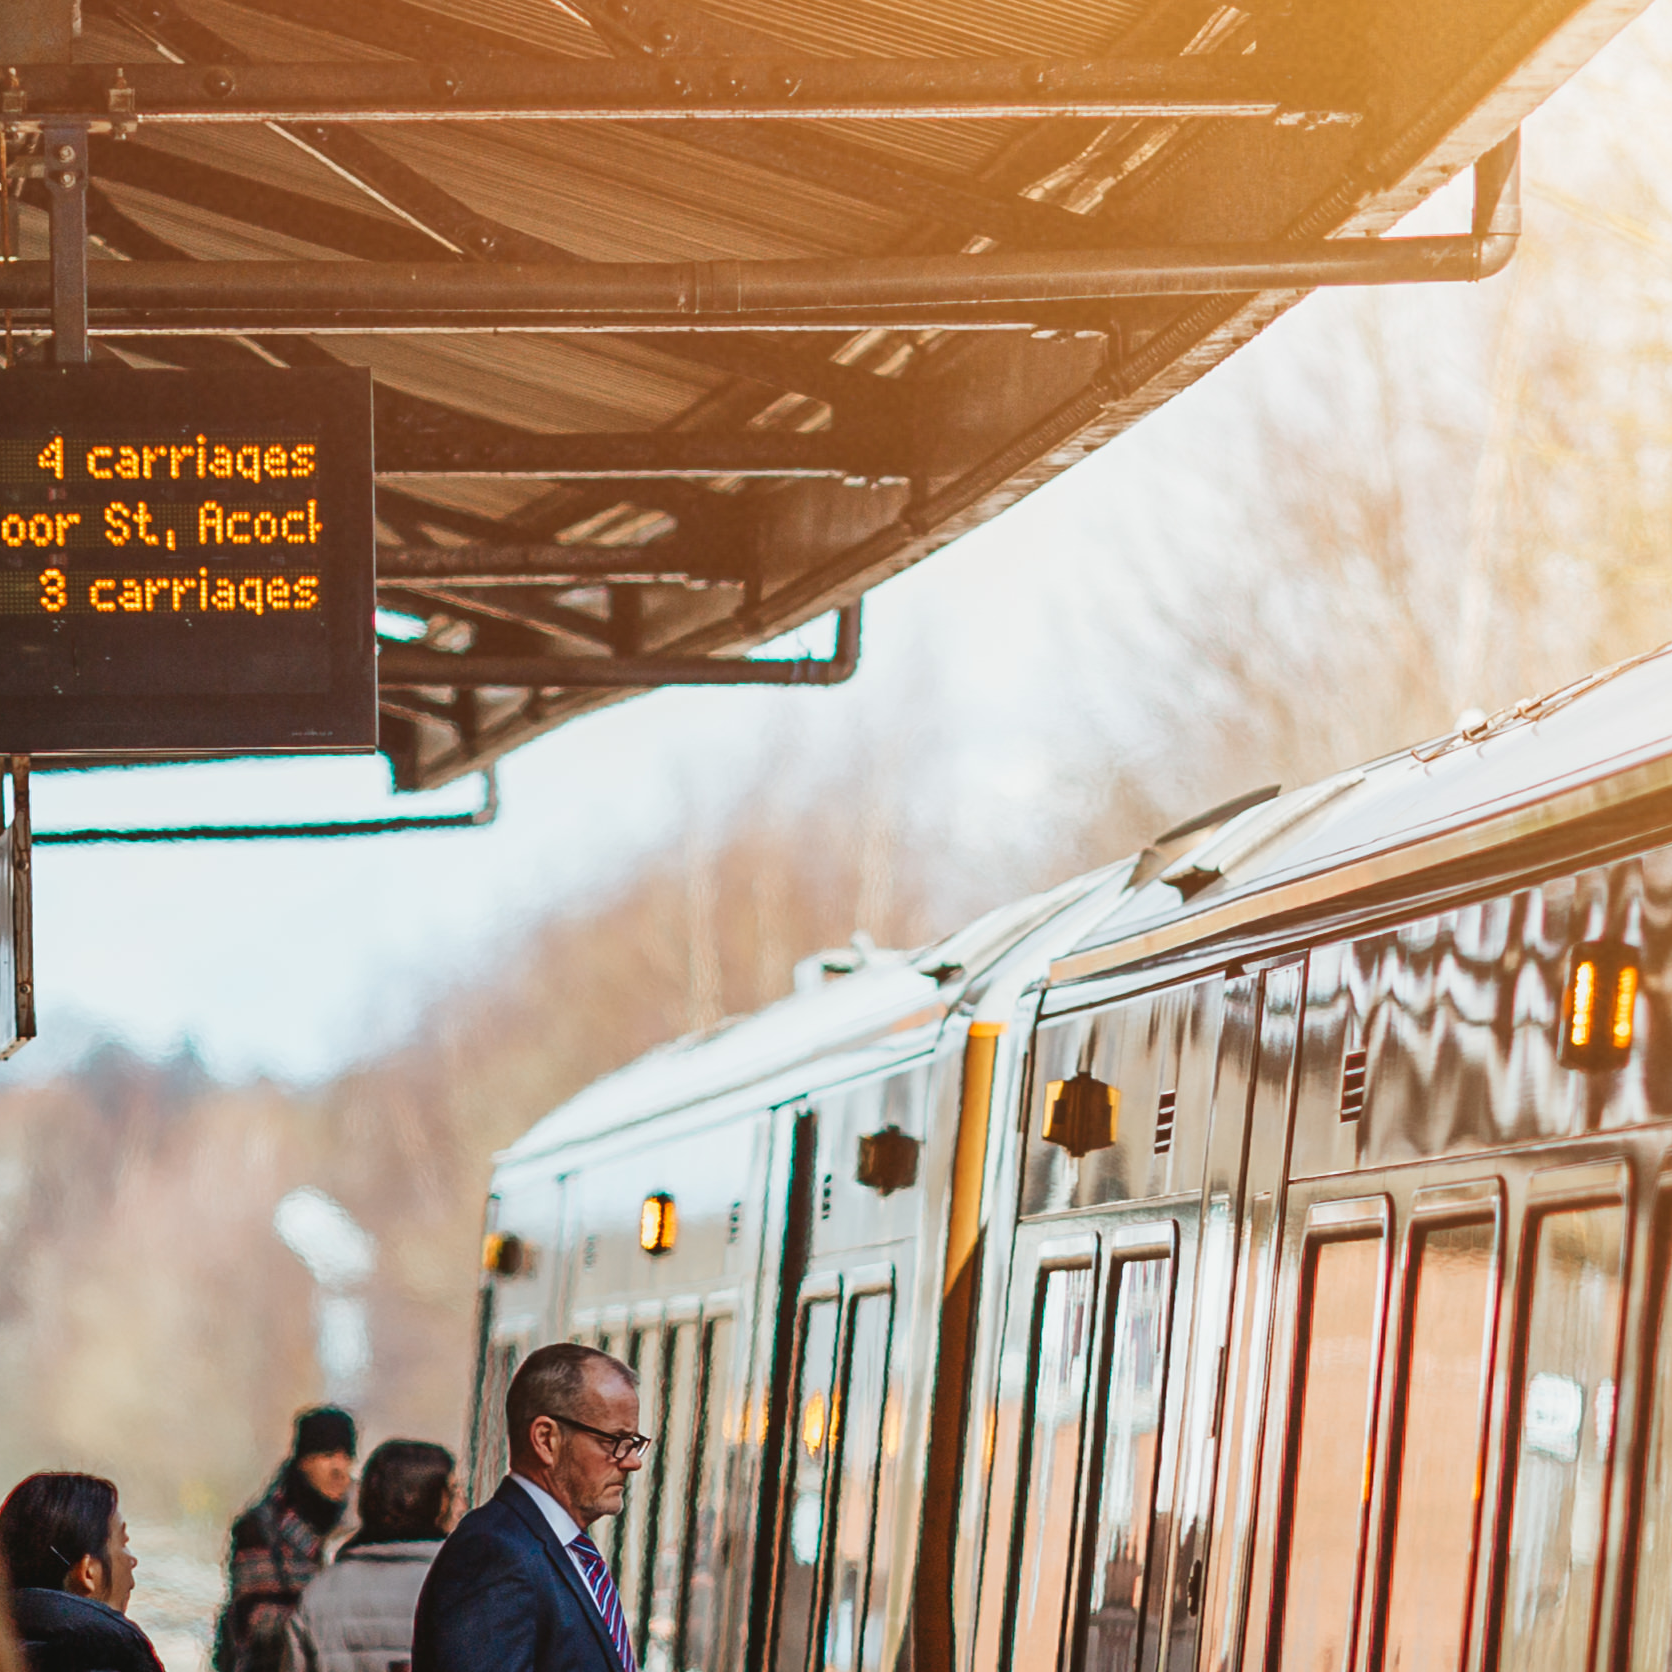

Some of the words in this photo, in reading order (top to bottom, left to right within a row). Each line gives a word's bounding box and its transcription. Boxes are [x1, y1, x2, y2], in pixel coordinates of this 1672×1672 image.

[38, 436, 64, 479] 4
[86, 433, 316, 484] carriages
[104, 501, 176, 551] St,
[39, 568, 67, 612] 3
[89, 566, 319, 616] carriages
